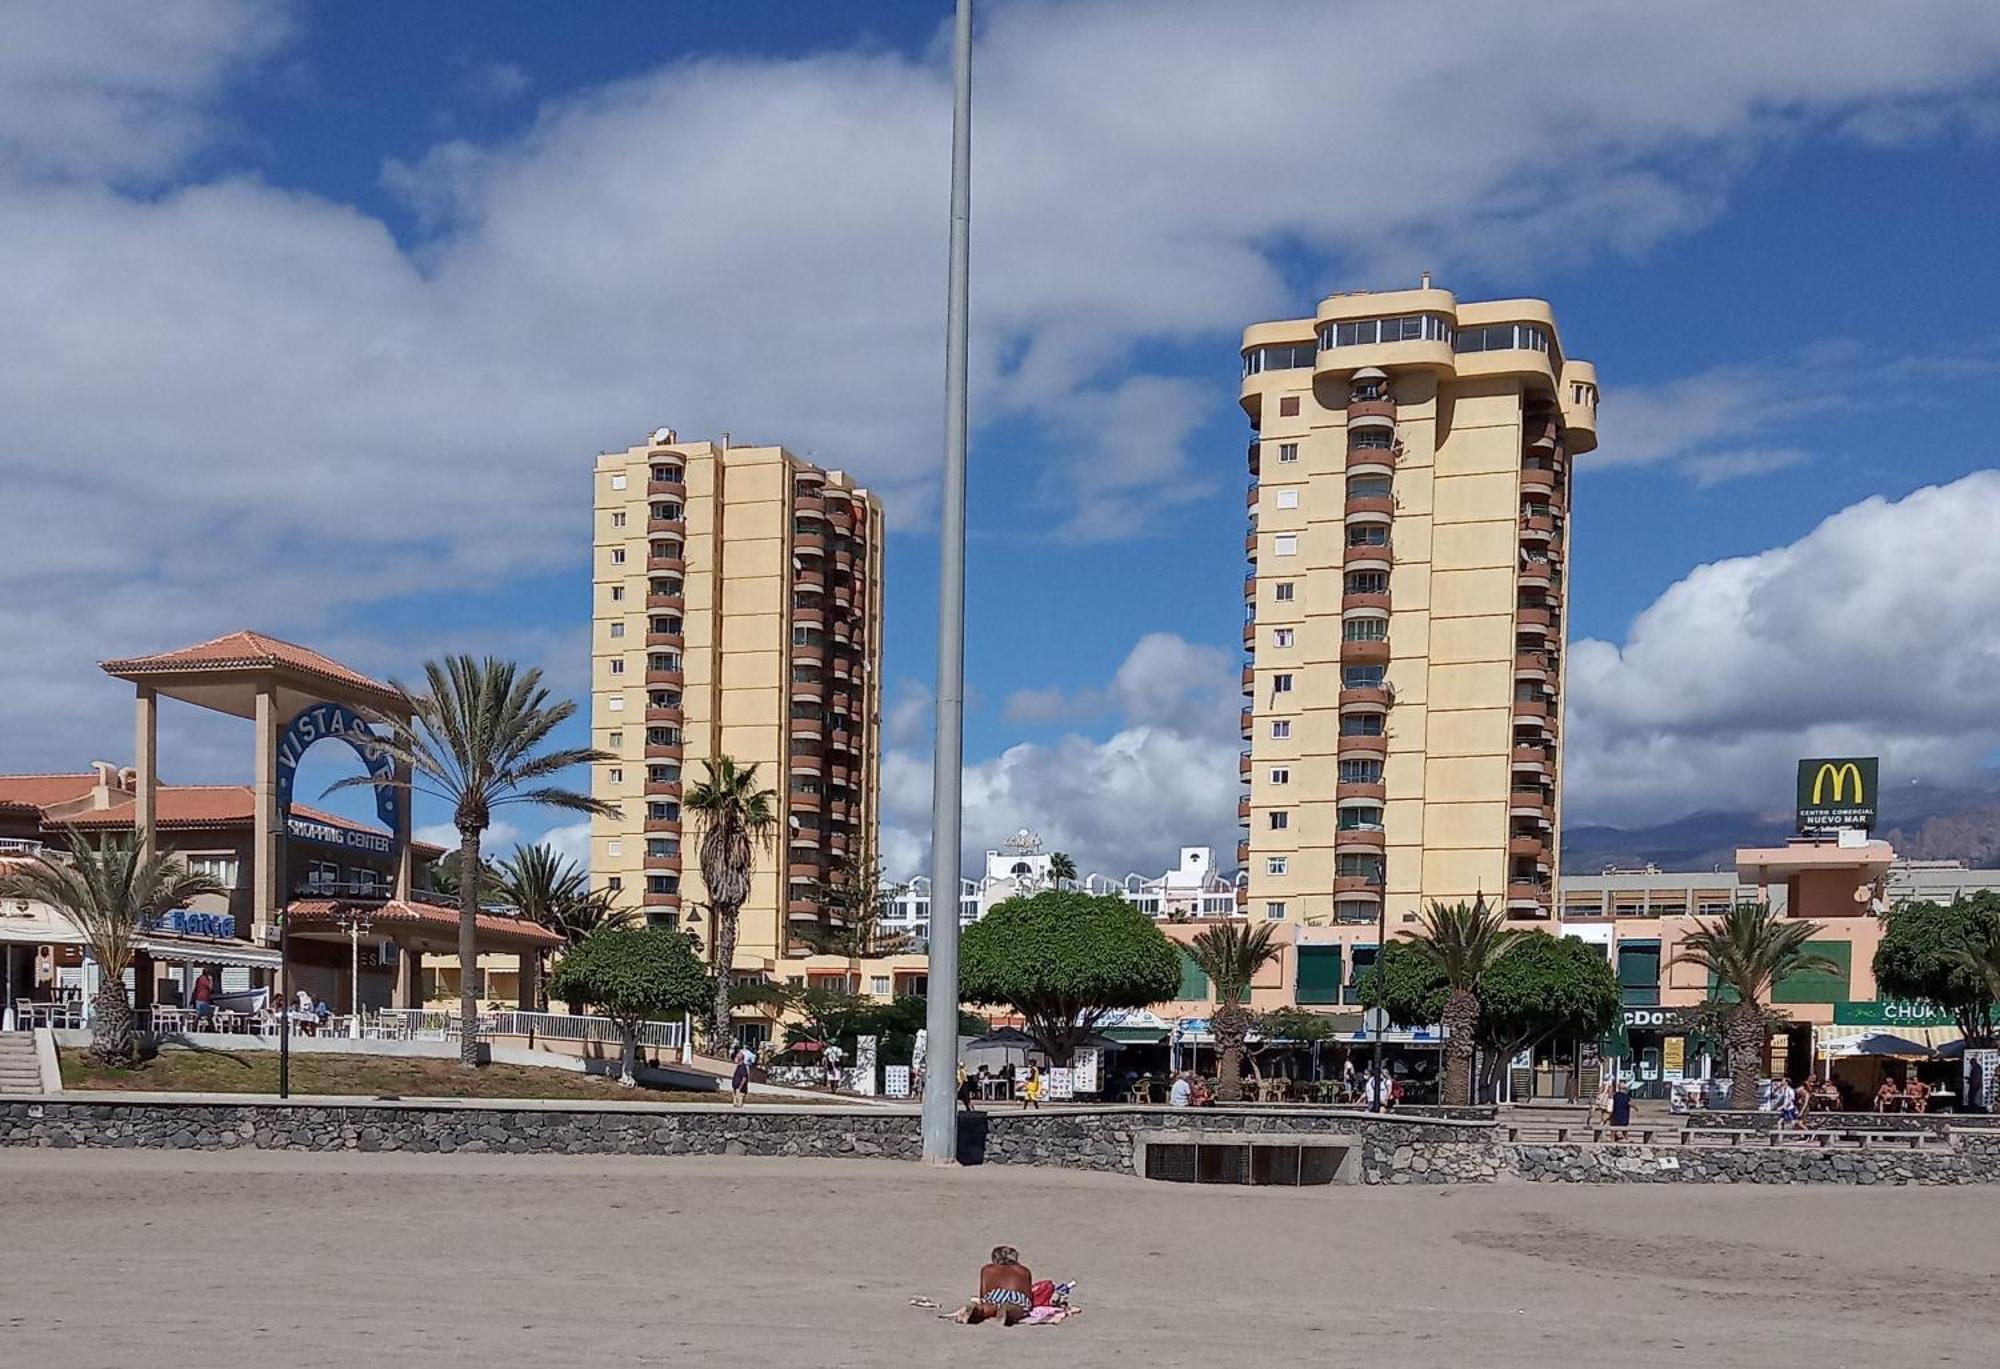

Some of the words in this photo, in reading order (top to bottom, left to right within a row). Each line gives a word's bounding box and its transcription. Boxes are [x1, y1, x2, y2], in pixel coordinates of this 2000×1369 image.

[279, 708, 345, 769] VISTA
[1807, 815, 1842, 824] NUEVO
[1844, 815, 1867, 823] MAR
[1832, 808, 1875, 816] COMERCIAL
[287, 819, 344, 844] SHOPPING
[347, 832, 390, 853] CENTER
